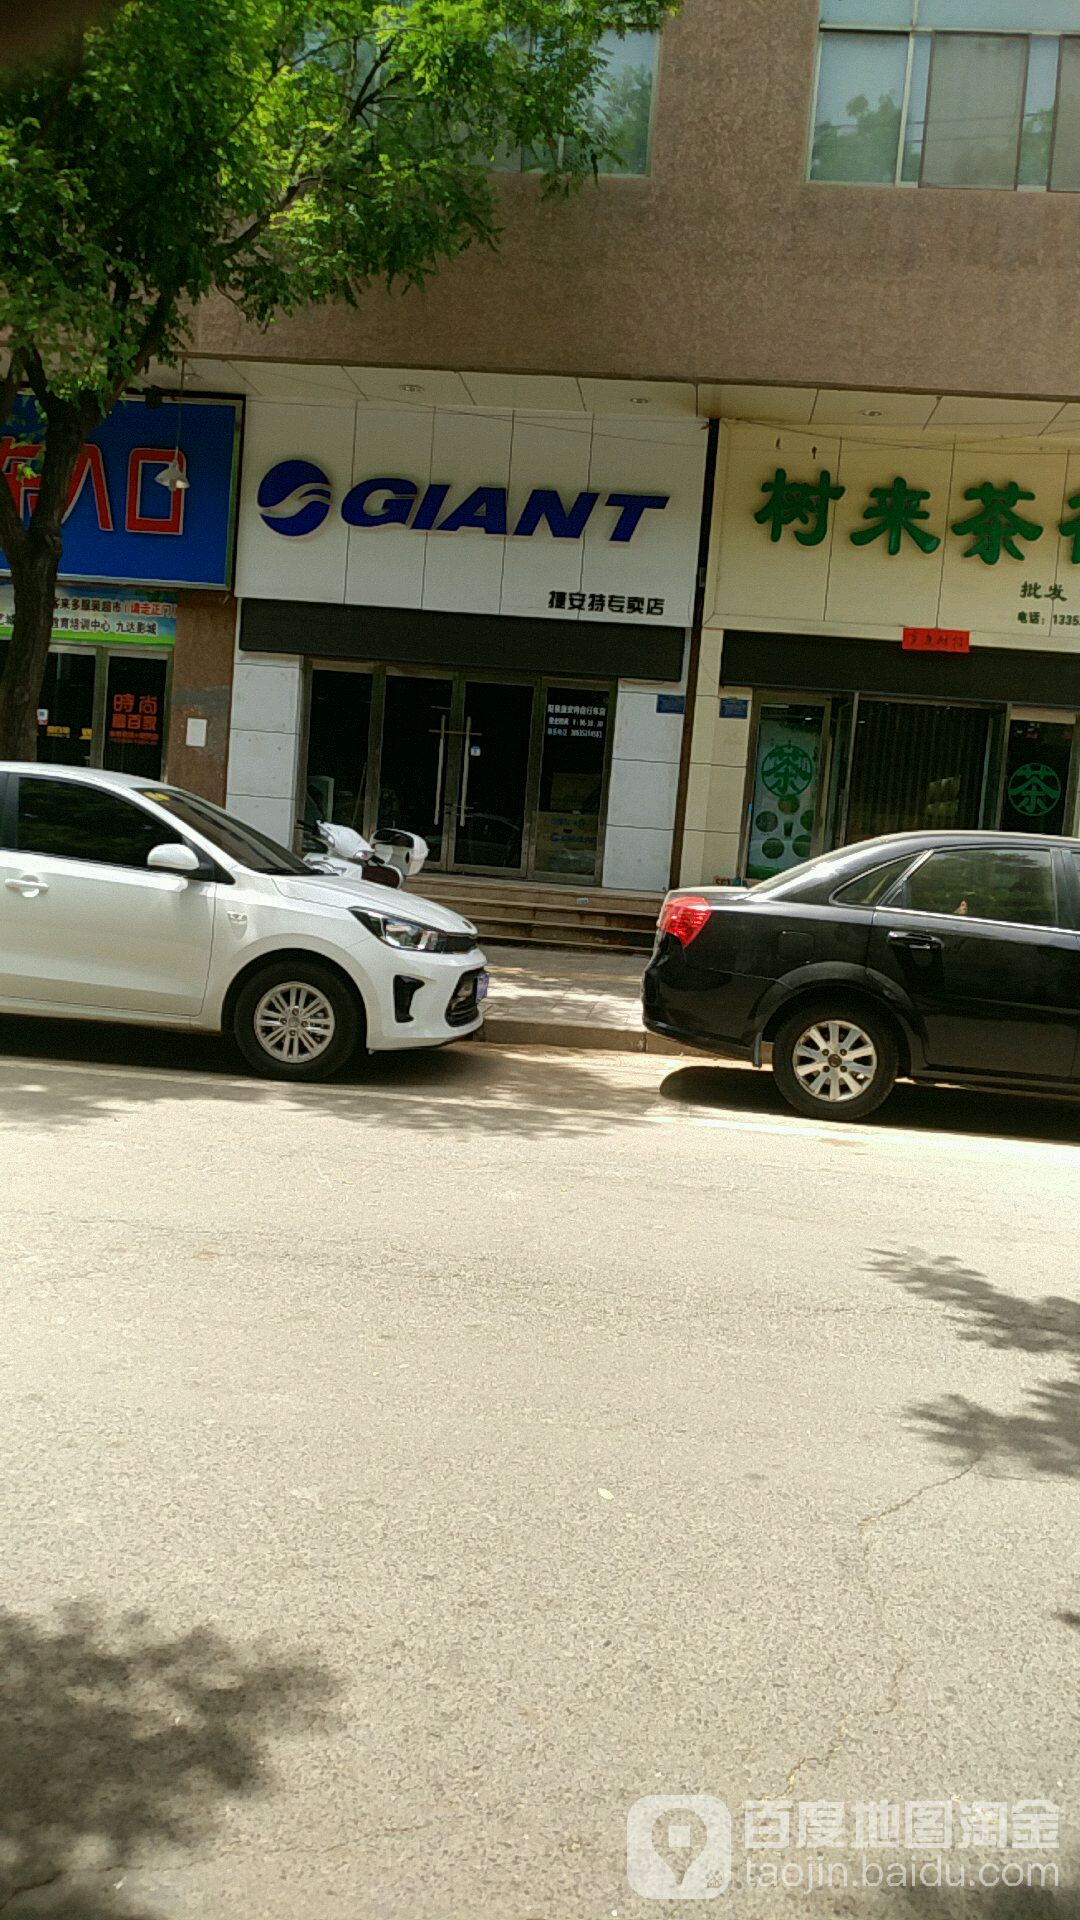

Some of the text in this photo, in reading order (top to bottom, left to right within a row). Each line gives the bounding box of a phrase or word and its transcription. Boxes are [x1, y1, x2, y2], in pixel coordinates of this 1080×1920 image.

[341, 478, 670, 542] GIANT
[1019, 580, 1068, 602] 批发
[548, 590, 666, 617] 捷安特专卖店
[1052, 614, 1080, 626] 1335
